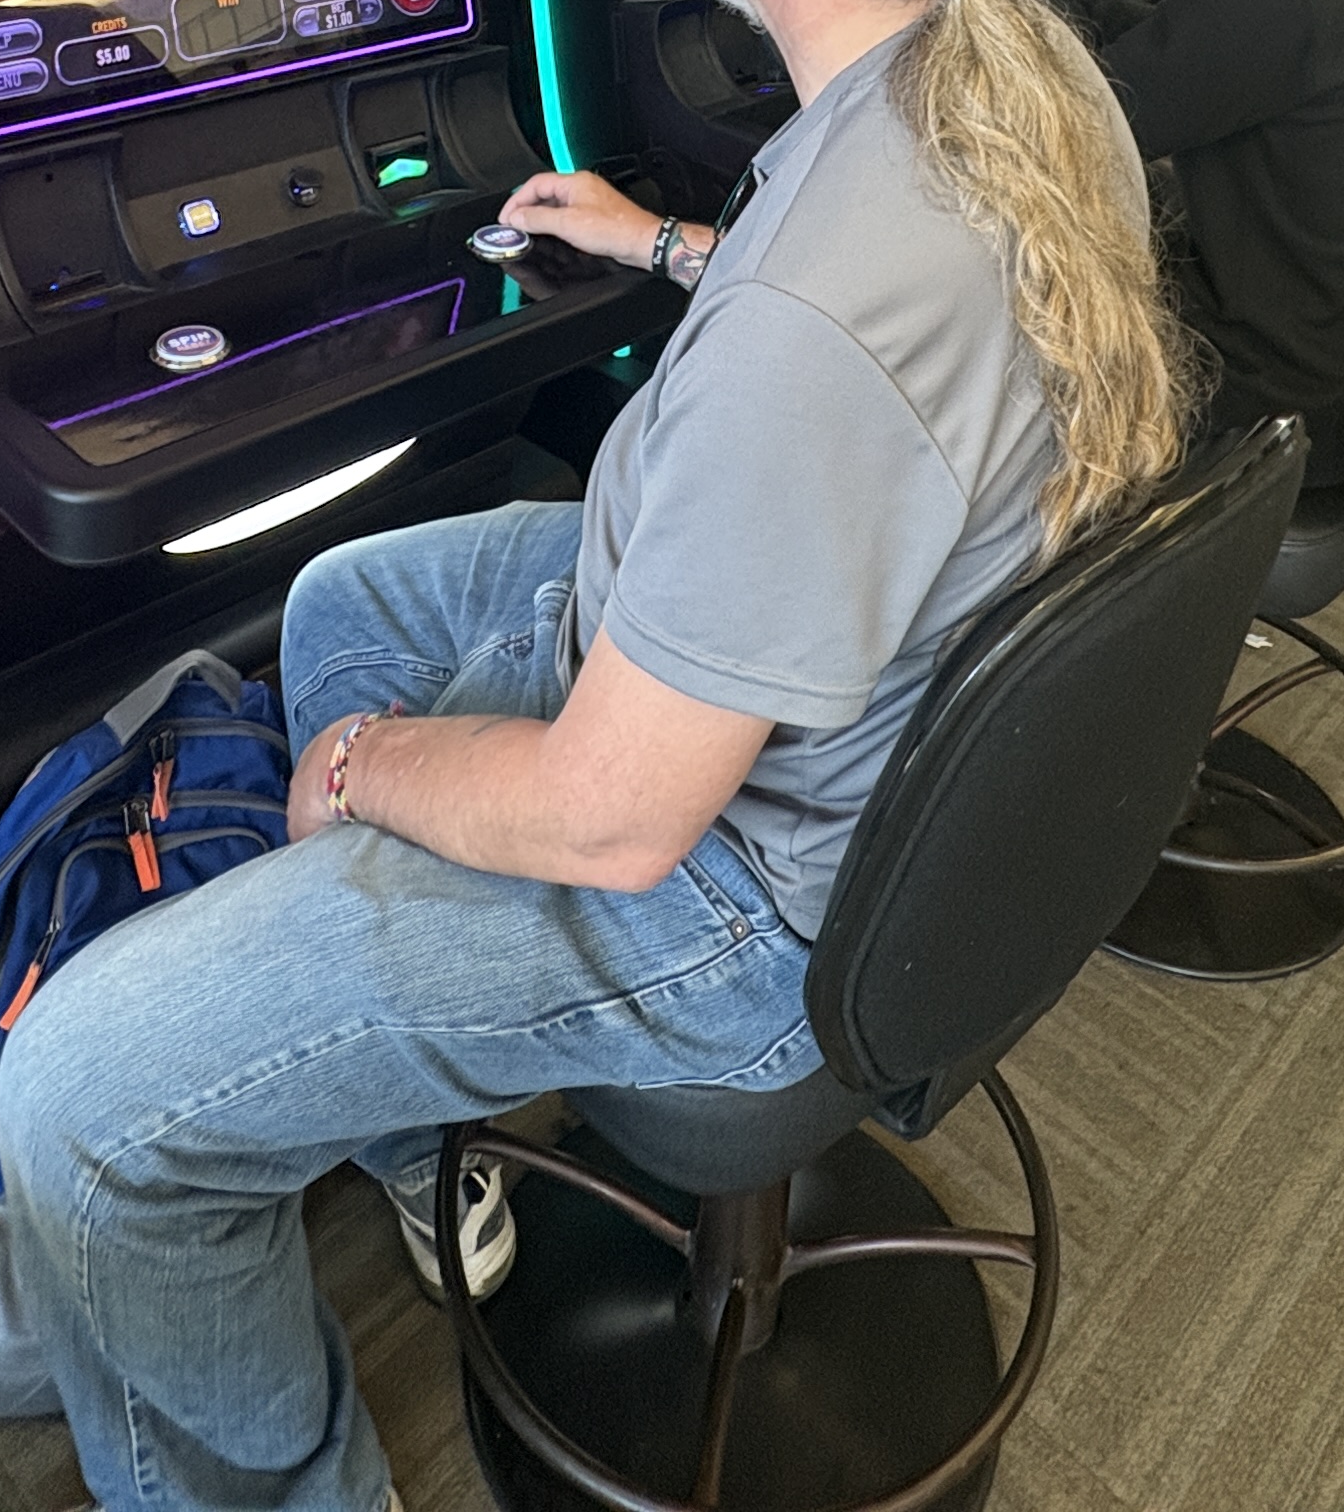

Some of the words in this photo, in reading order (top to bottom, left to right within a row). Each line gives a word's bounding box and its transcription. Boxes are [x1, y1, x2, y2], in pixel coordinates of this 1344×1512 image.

[331, 2, 346, 14] BET
[92, 17, 128, 34] CREDITS
[325, 11, 353, 29] $1.00
[96, 45, 131, 67] $5.00
[167, 331, 211, 348] SPIN
